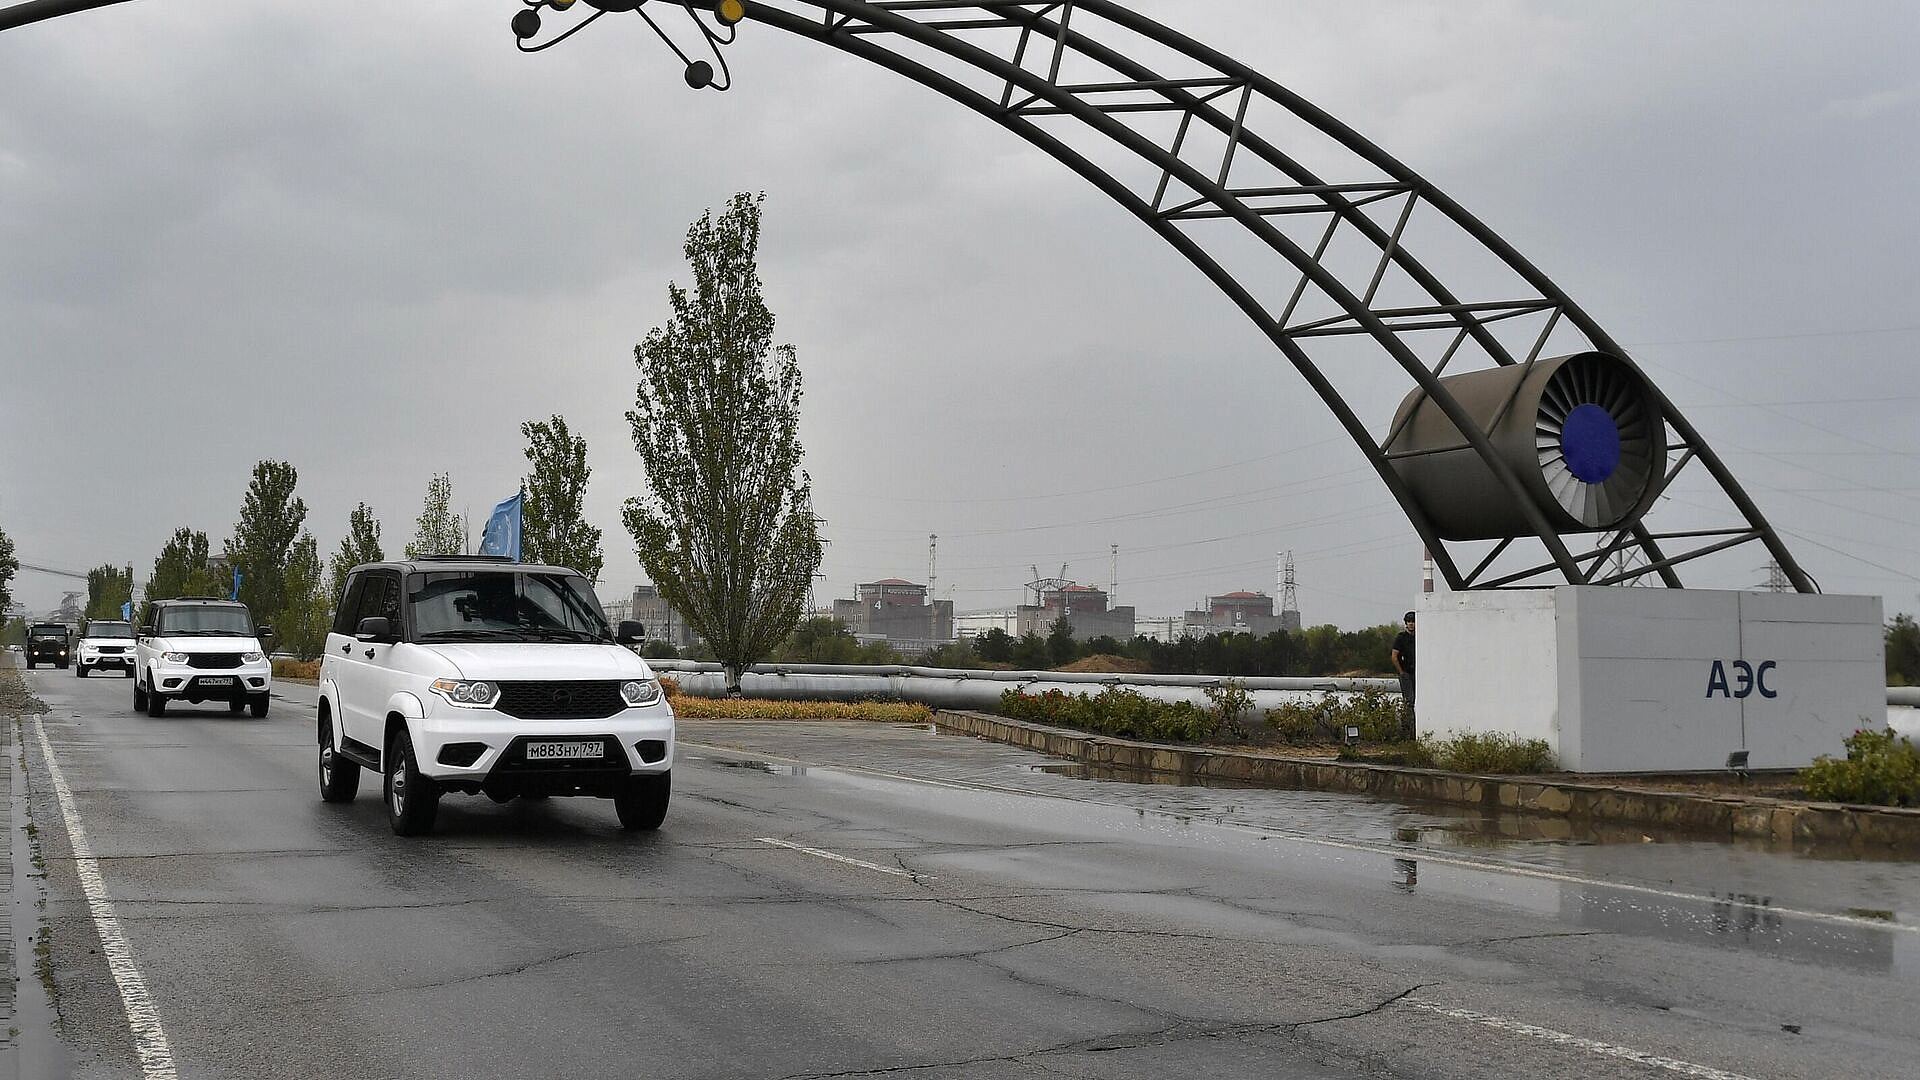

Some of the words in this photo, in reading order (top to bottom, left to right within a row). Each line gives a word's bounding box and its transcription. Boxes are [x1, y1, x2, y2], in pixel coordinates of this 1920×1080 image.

[874, 600, 882, 610] 4
[1064, 606, 1071, 615] 5
[1236, 611, 1241, 620] 6
[1706, 660, 1777, 698] АЭС
